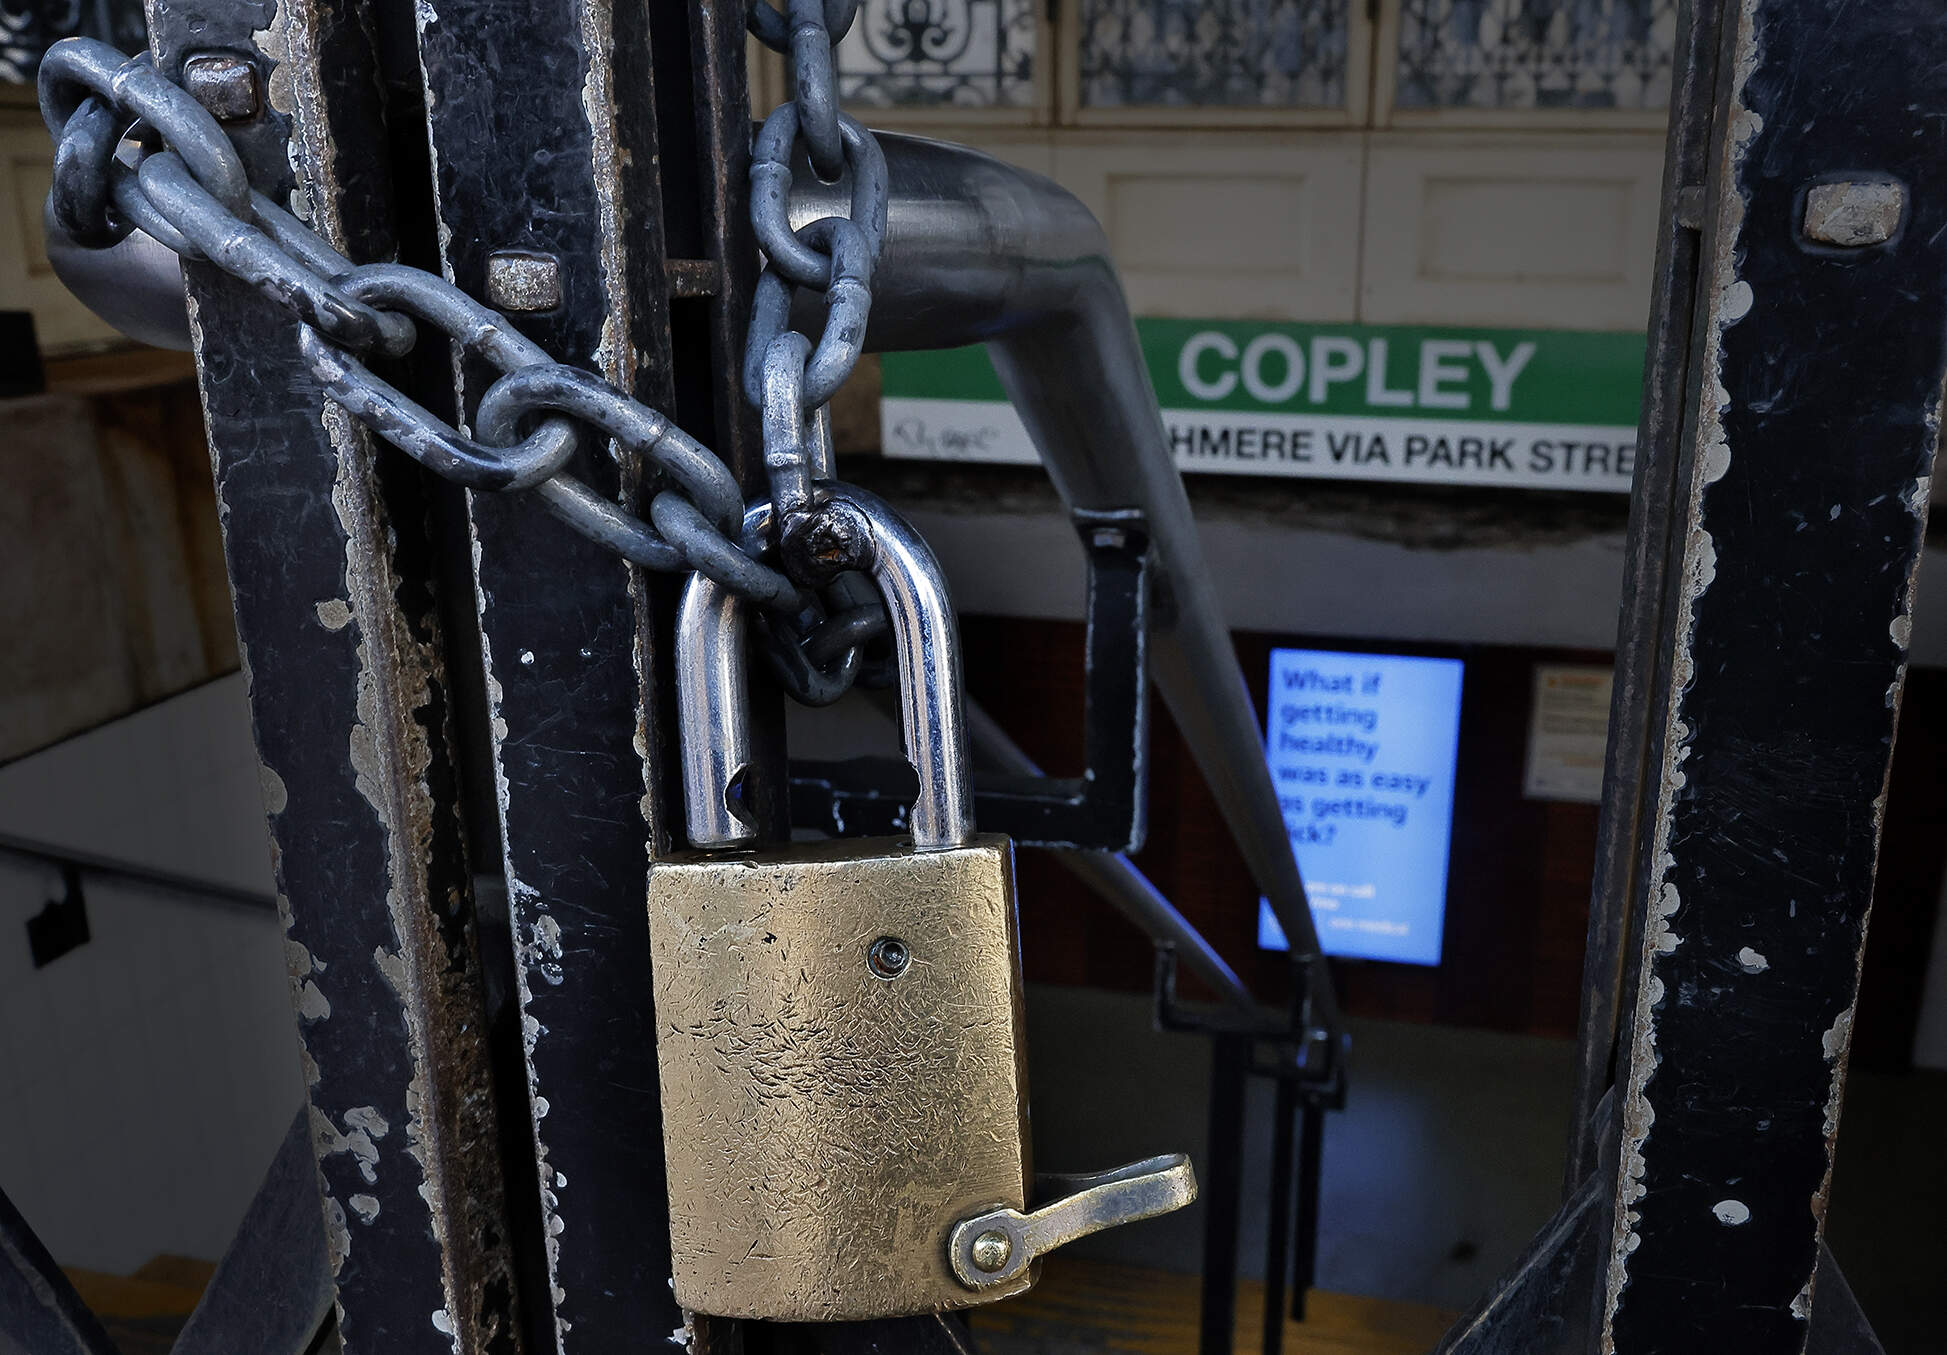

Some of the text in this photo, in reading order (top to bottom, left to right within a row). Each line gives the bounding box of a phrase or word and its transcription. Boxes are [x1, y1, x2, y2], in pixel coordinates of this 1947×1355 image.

[1178, 329, 1538, 412] COPLEY
[1326, 432, 1391, 465] VIA
[1404, 435, 1516, 473] PARK
[1529, 440, 1637, 477] STRE
[1282, 668, 1383, 696] What if
[1280, 703, 1379, 735] getting
[1278, 731, 1380, 766] healthy
[1277, 765, 1432, 800] was as easy
[1311, 796, 1408, 830] getting
